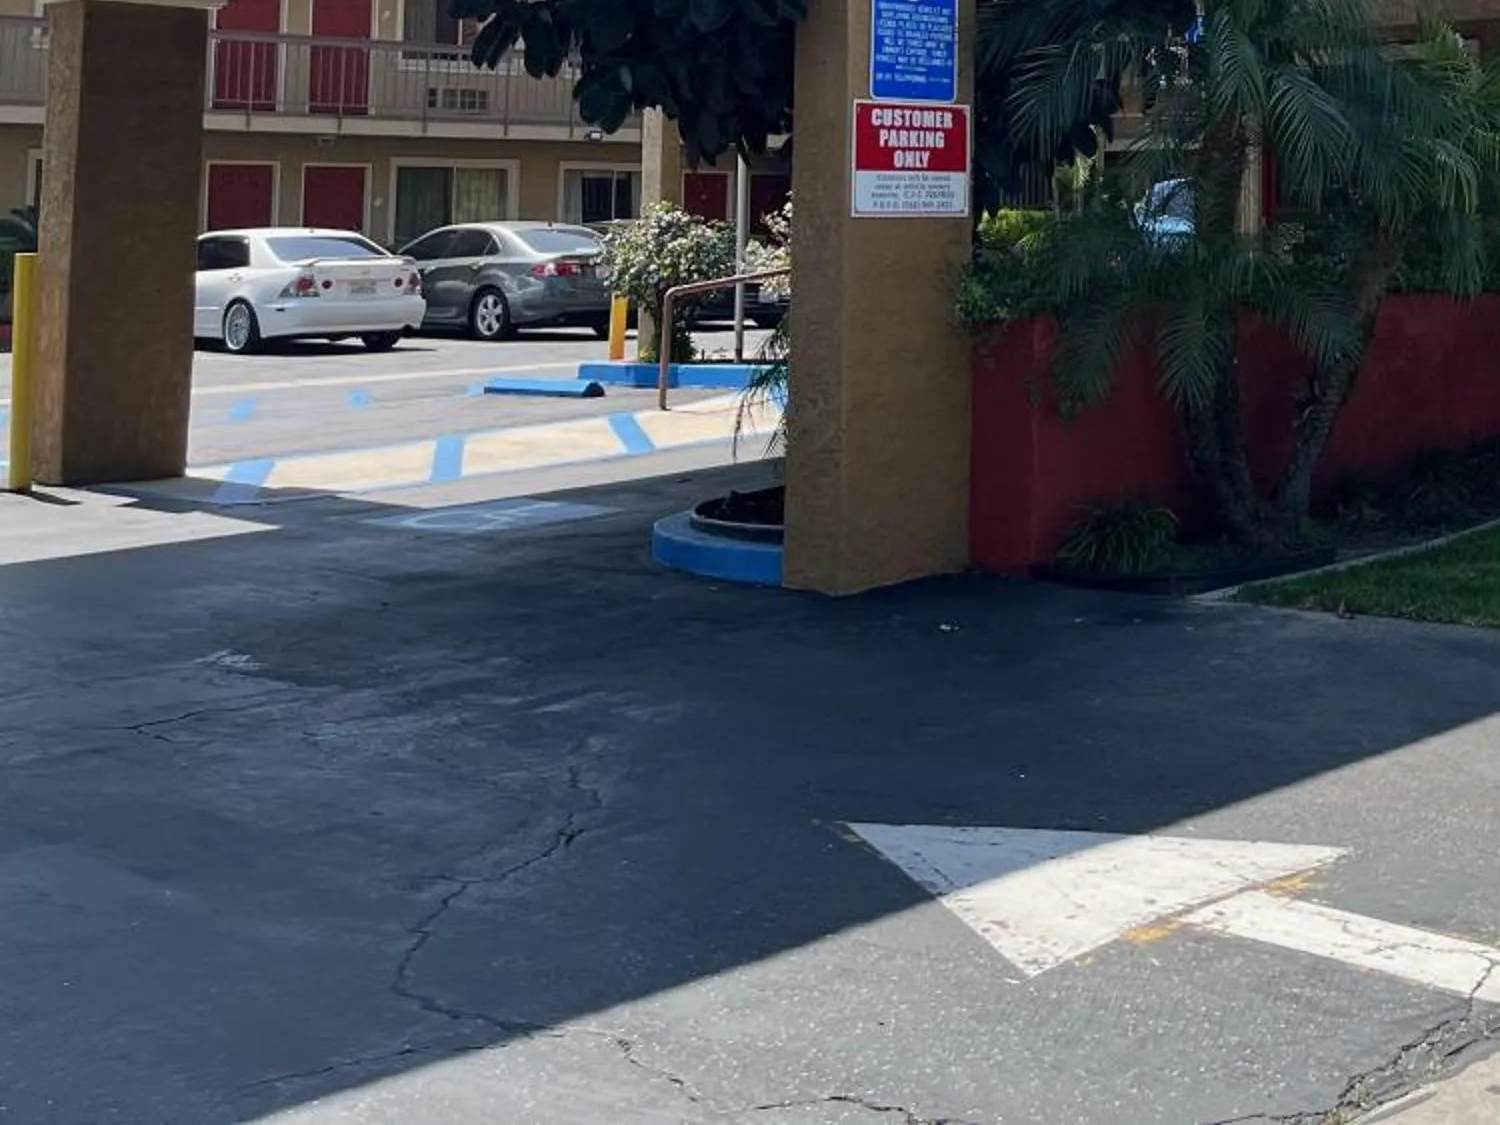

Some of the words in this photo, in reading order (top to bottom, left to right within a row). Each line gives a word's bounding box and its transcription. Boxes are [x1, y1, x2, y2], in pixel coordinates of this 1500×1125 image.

[871, 108, 953, 129] CUSTOMER
[879, 128, 945, 148] PARKING
[893, 149, 930, 168] ONLY
